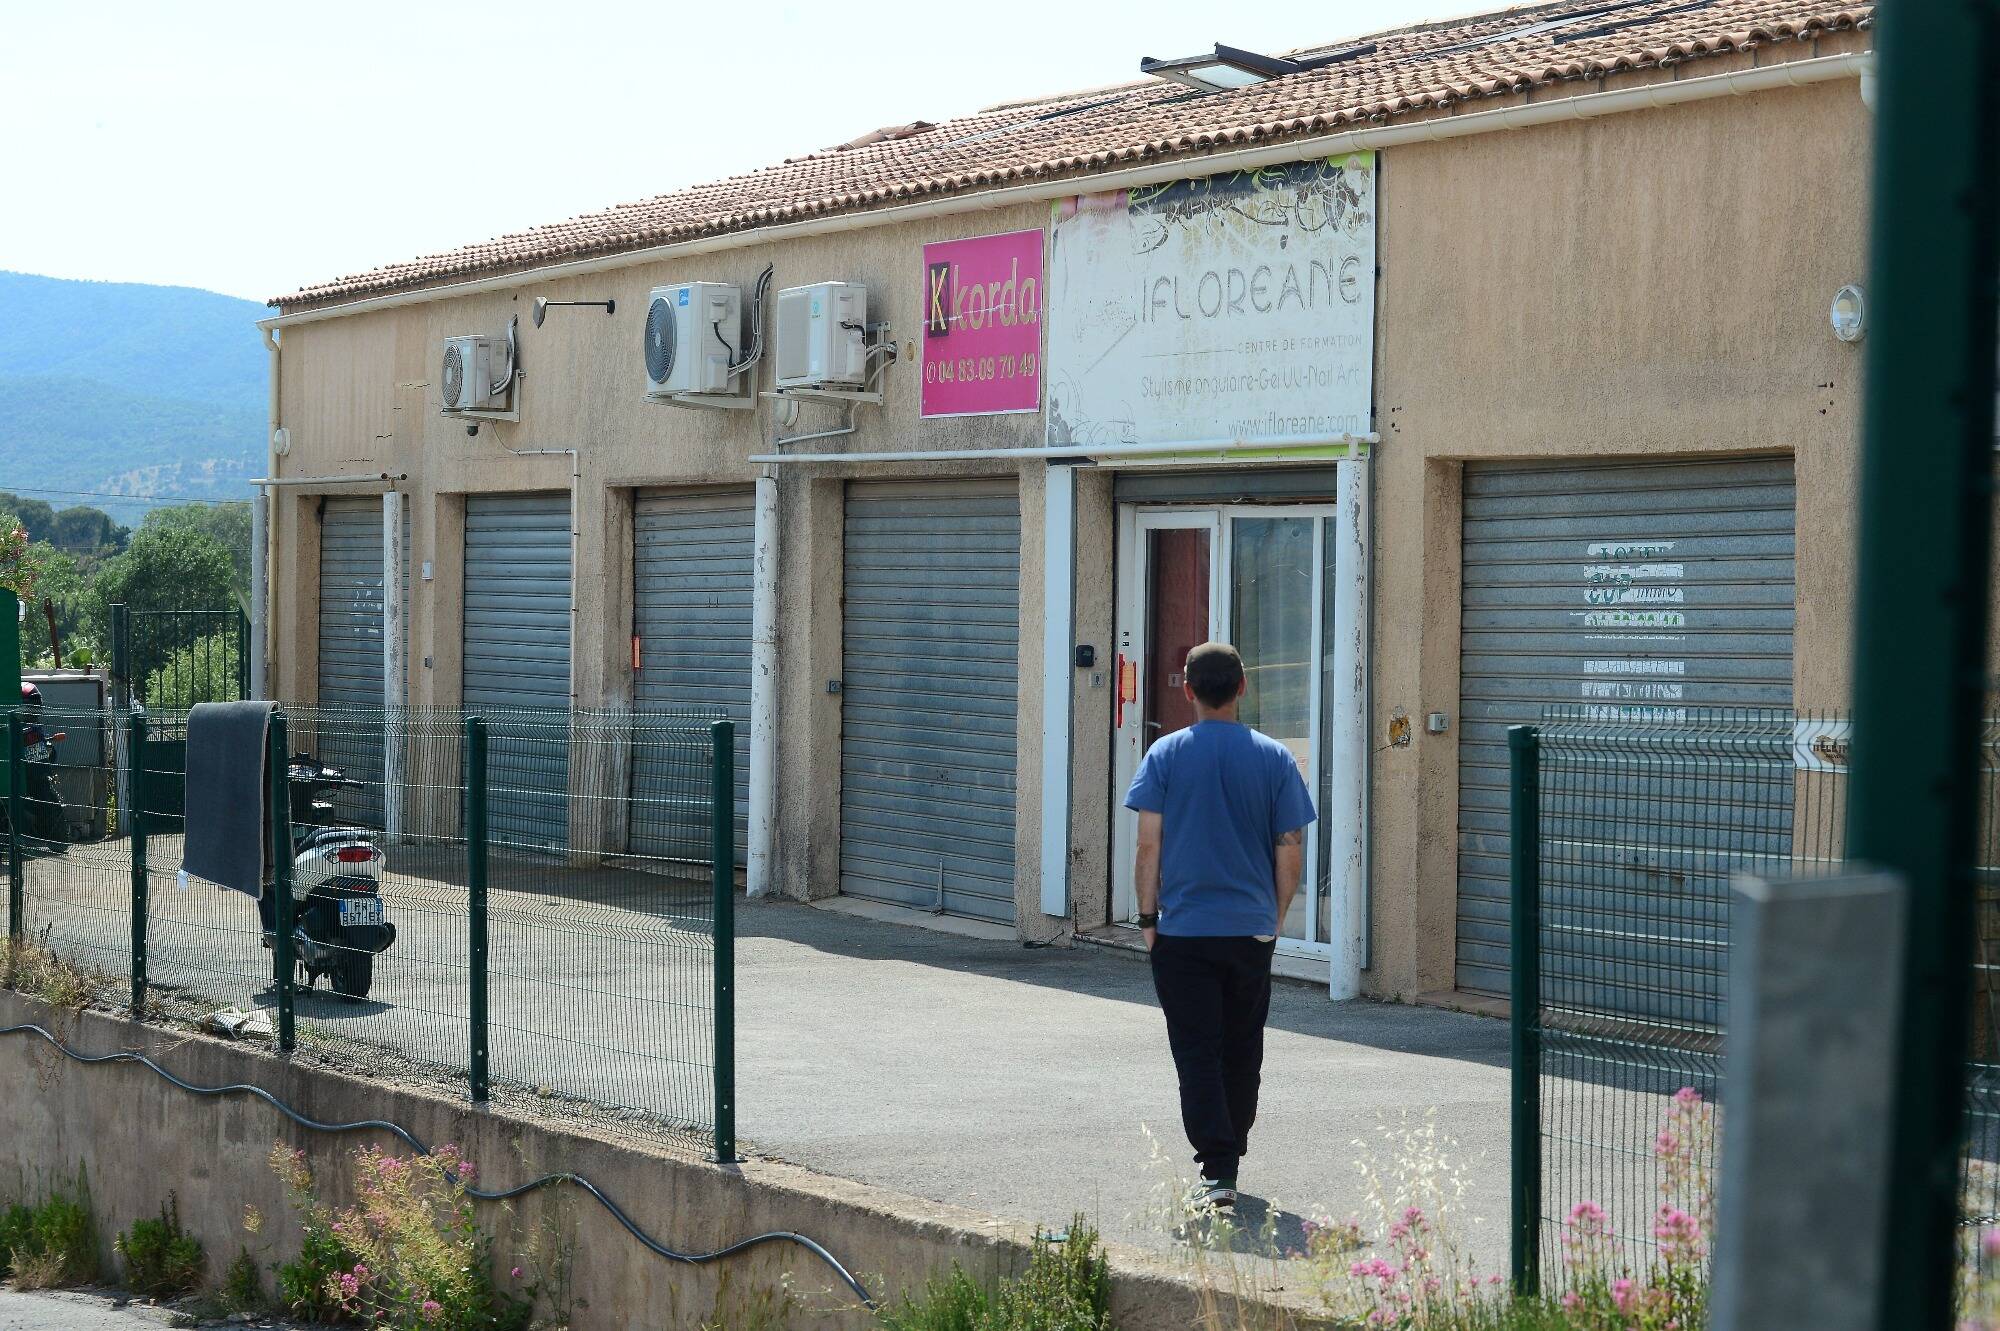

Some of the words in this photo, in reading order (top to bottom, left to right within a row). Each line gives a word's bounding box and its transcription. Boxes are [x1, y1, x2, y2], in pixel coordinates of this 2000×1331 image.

[952, 257, 1036, 332] korda
[1238, 338, 1278, 354] CENTRE
[1282, 338, 1297, 351] DE
[1300, 334, 1362, 352] FORMATION
[938, 359, 954, 384] 04
[1000, 353, 1015, 378] 70
[1020, 351, 1035, 376] 49
[1140, 375, 1192, 399] Stylisme
[1337, 362, 1359, 384] Art
[1228, 411, 1358, 436] www.ifloreane.com
